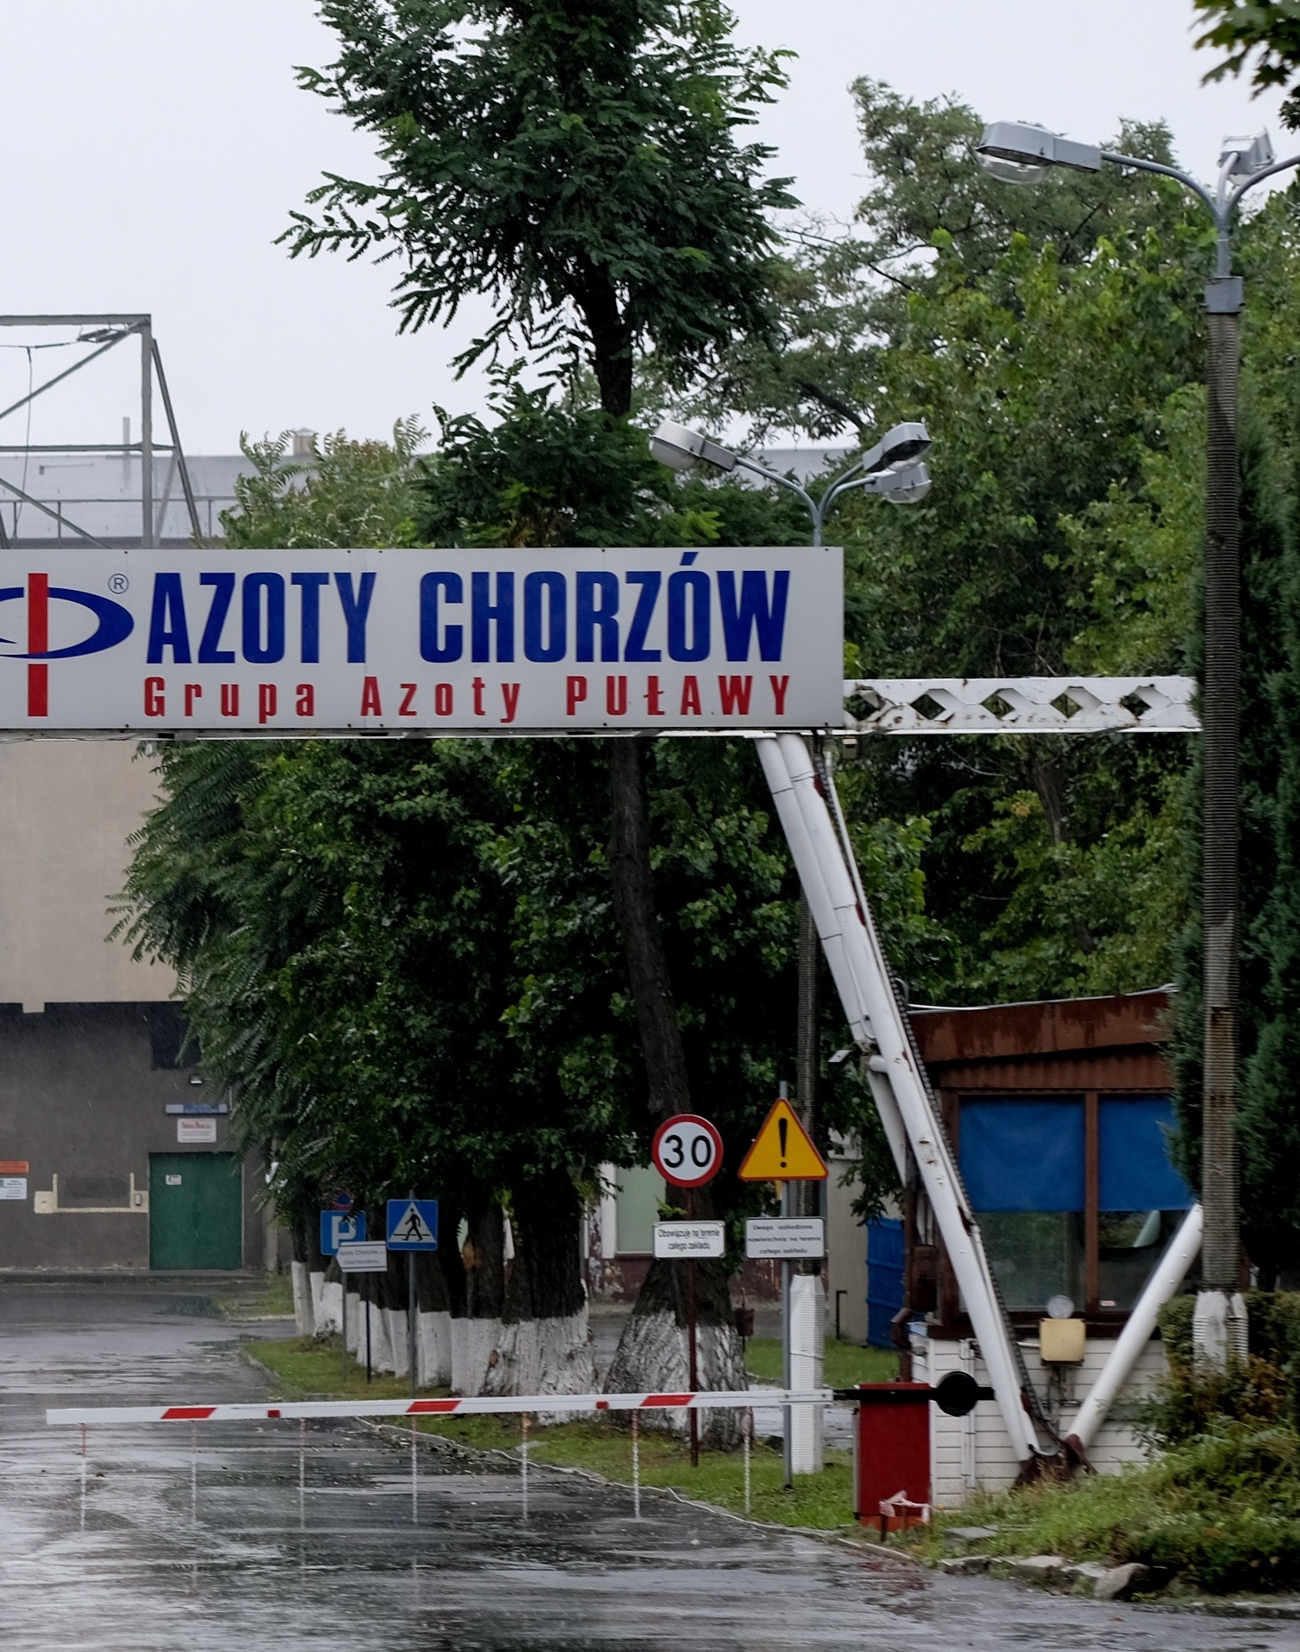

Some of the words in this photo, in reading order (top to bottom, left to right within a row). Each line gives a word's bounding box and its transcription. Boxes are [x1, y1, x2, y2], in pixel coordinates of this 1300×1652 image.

[146, 571, 377, 664] AZOTY
[420, 551, 791, 663] CHORZÓW
[144, 677, 314, 724] Grupa
[361, 676, 520, 723] Azoty
[566, 675, 789, 716] PUŁAWY
[663, 1134, 712, 1169] 30
[331, 1216, 356, 1249] P
